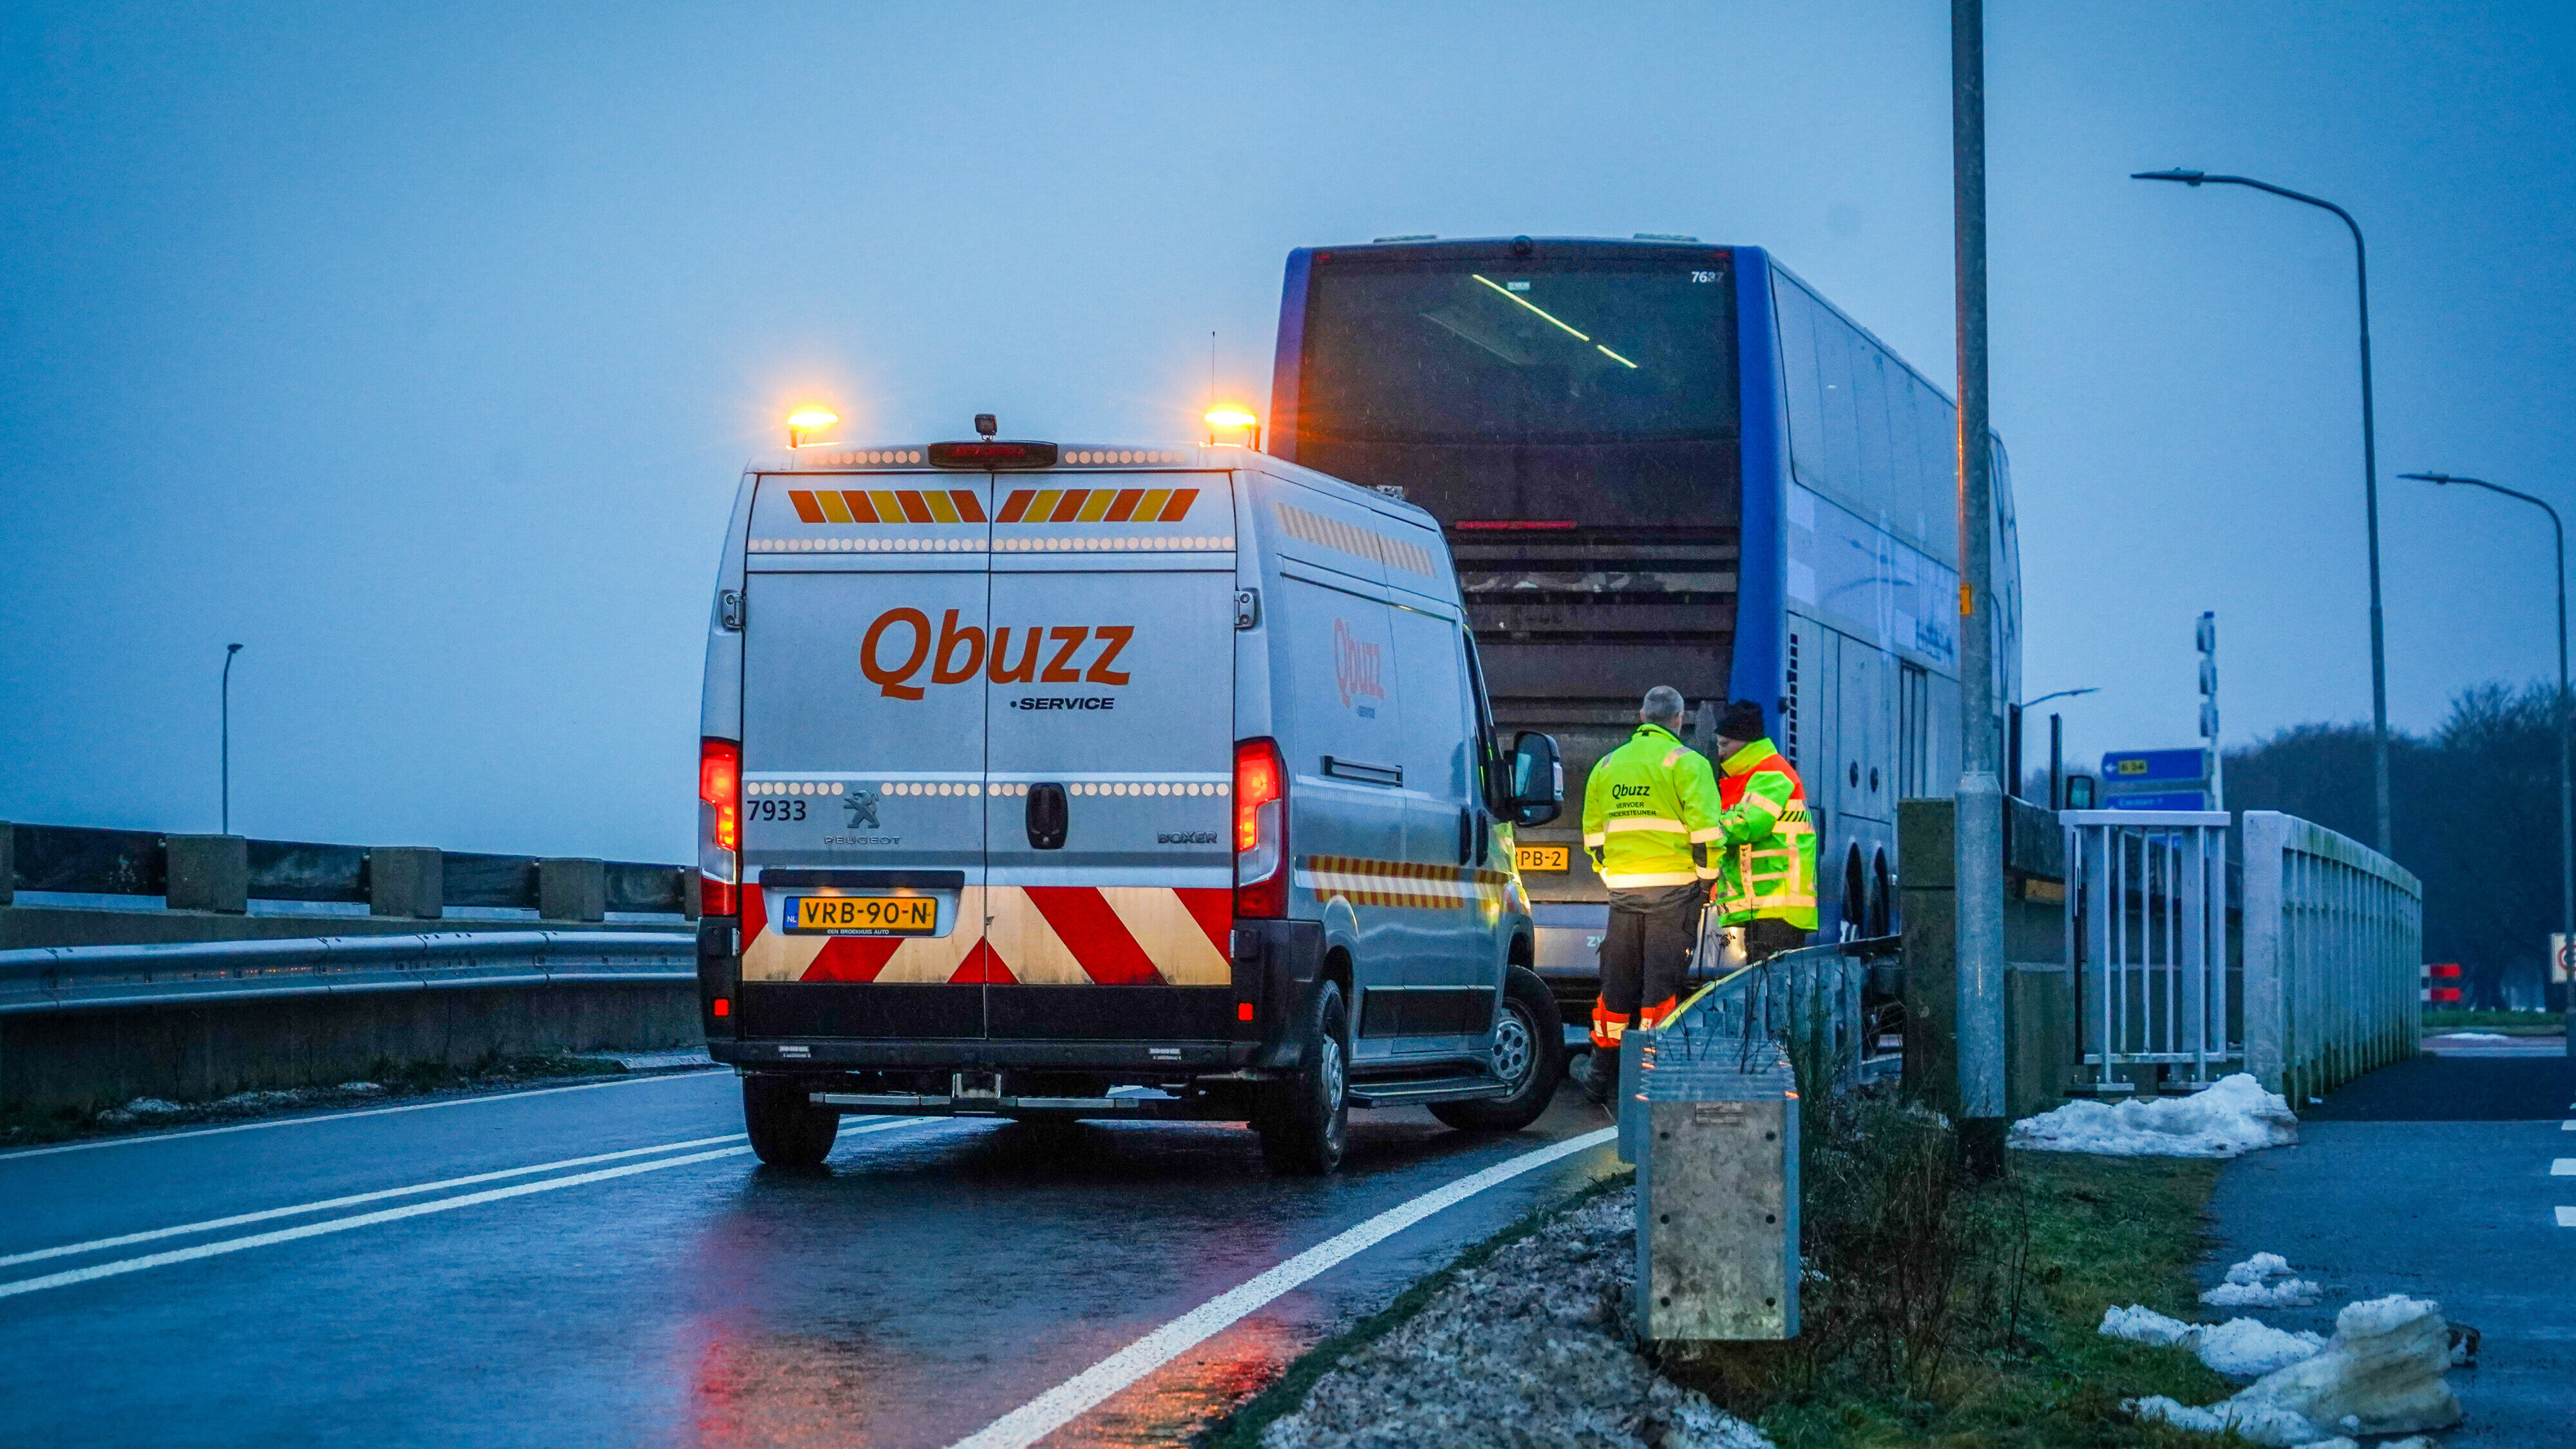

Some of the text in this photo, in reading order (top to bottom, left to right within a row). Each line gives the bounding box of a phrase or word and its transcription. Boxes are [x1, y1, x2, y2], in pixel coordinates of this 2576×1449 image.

[860, 607, 1135, 701] Qbuzz
[1019, 697, 1115, 710] SERVICE
[1612, 784, 1651, 799] Qbuzz
[747, 800, 807, 821] 7933
[824, 836, 902, 844] PEUGEOT
[1157, 831, 1218, 844] BOXER
[1516, 851, 1561, 866] PB-2
[805, 902, 927, 924] VRB-90-N
